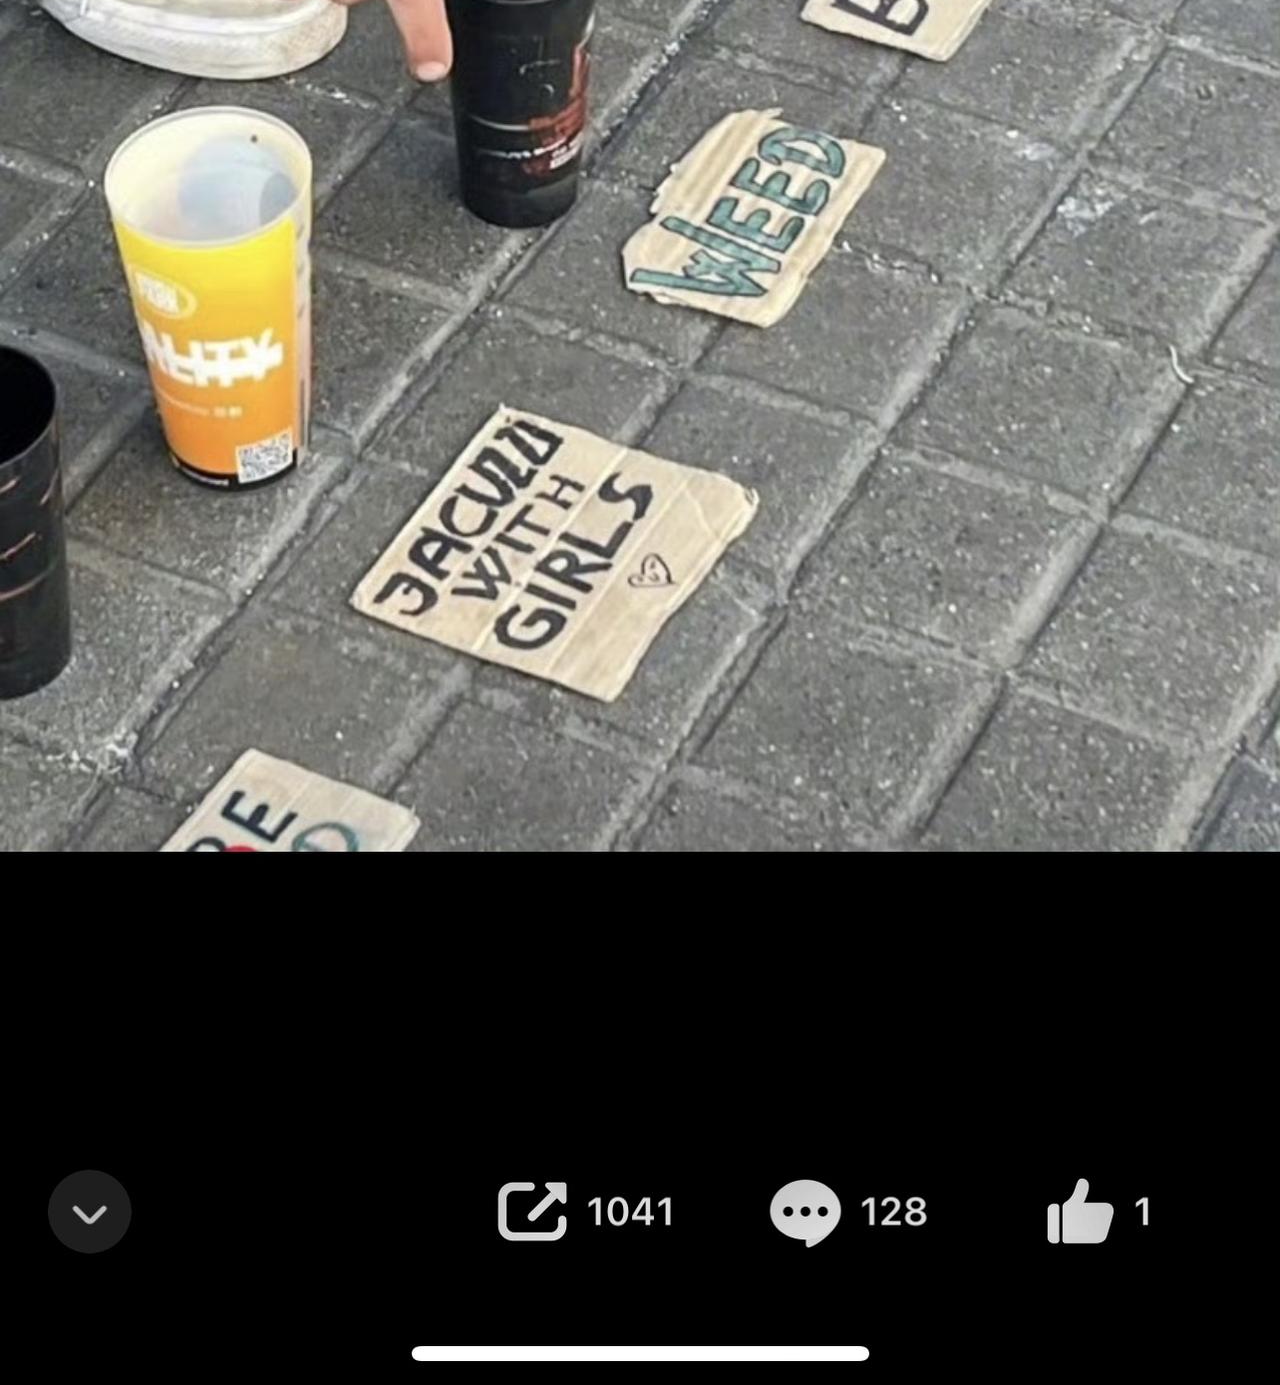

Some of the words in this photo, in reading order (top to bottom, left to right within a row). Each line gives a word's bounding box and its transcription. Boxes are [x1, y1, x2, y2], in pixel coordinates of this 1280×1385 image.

[630, 127, 846, 297] WEED
[451, 474, 585, 601] WITH
[494, 472, 653, 651] GIRLS
